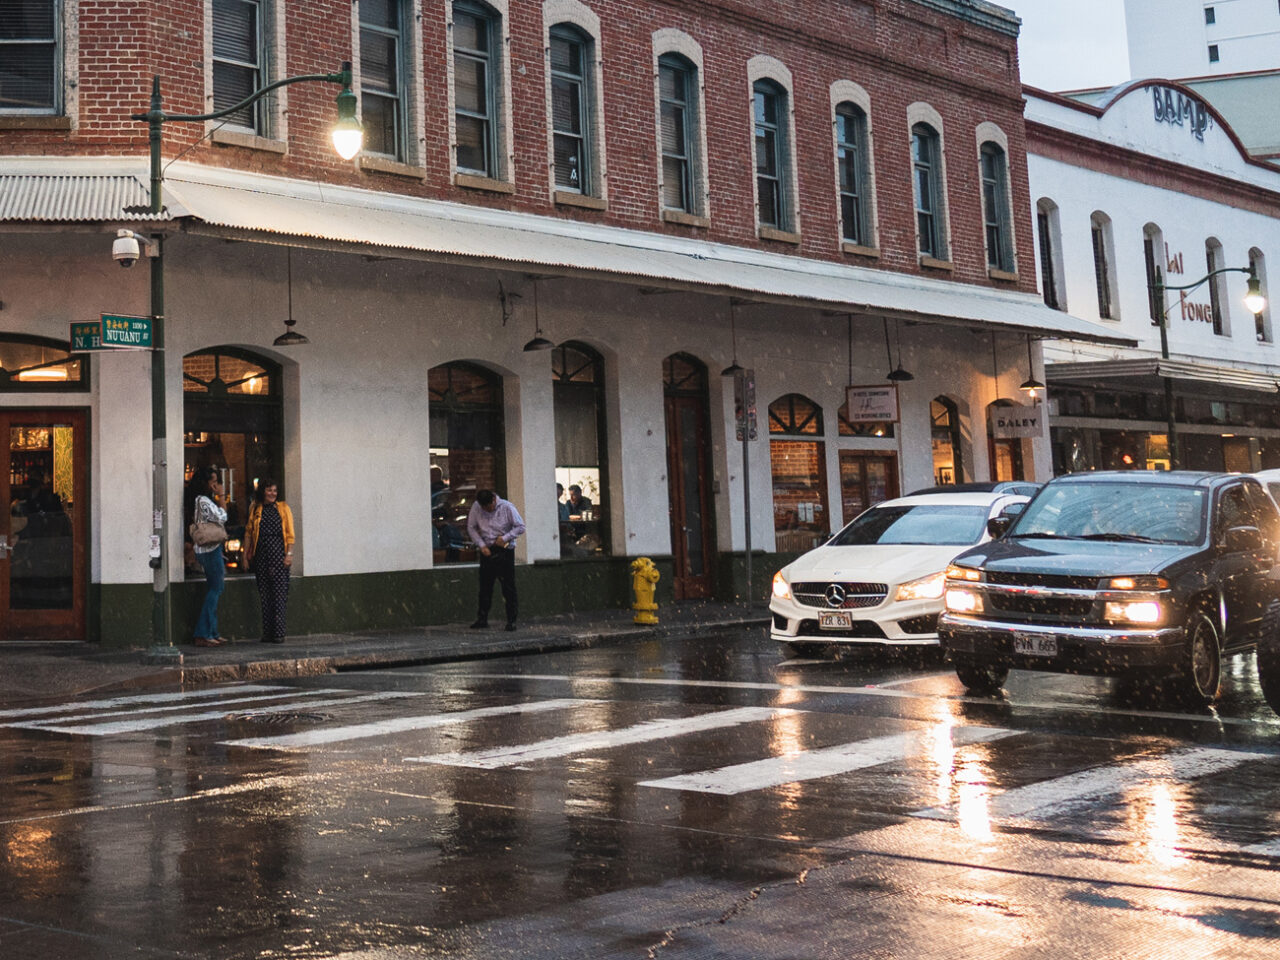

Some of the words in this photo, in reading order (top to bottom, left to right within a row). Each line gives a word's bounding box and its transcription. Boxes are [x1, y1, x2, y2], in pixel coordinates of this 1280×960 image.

[1165, 241, 1184, 275] LAI
[1180, 289, 1212, 324] FONG
[997, 418, 1037, 428] DALEY
